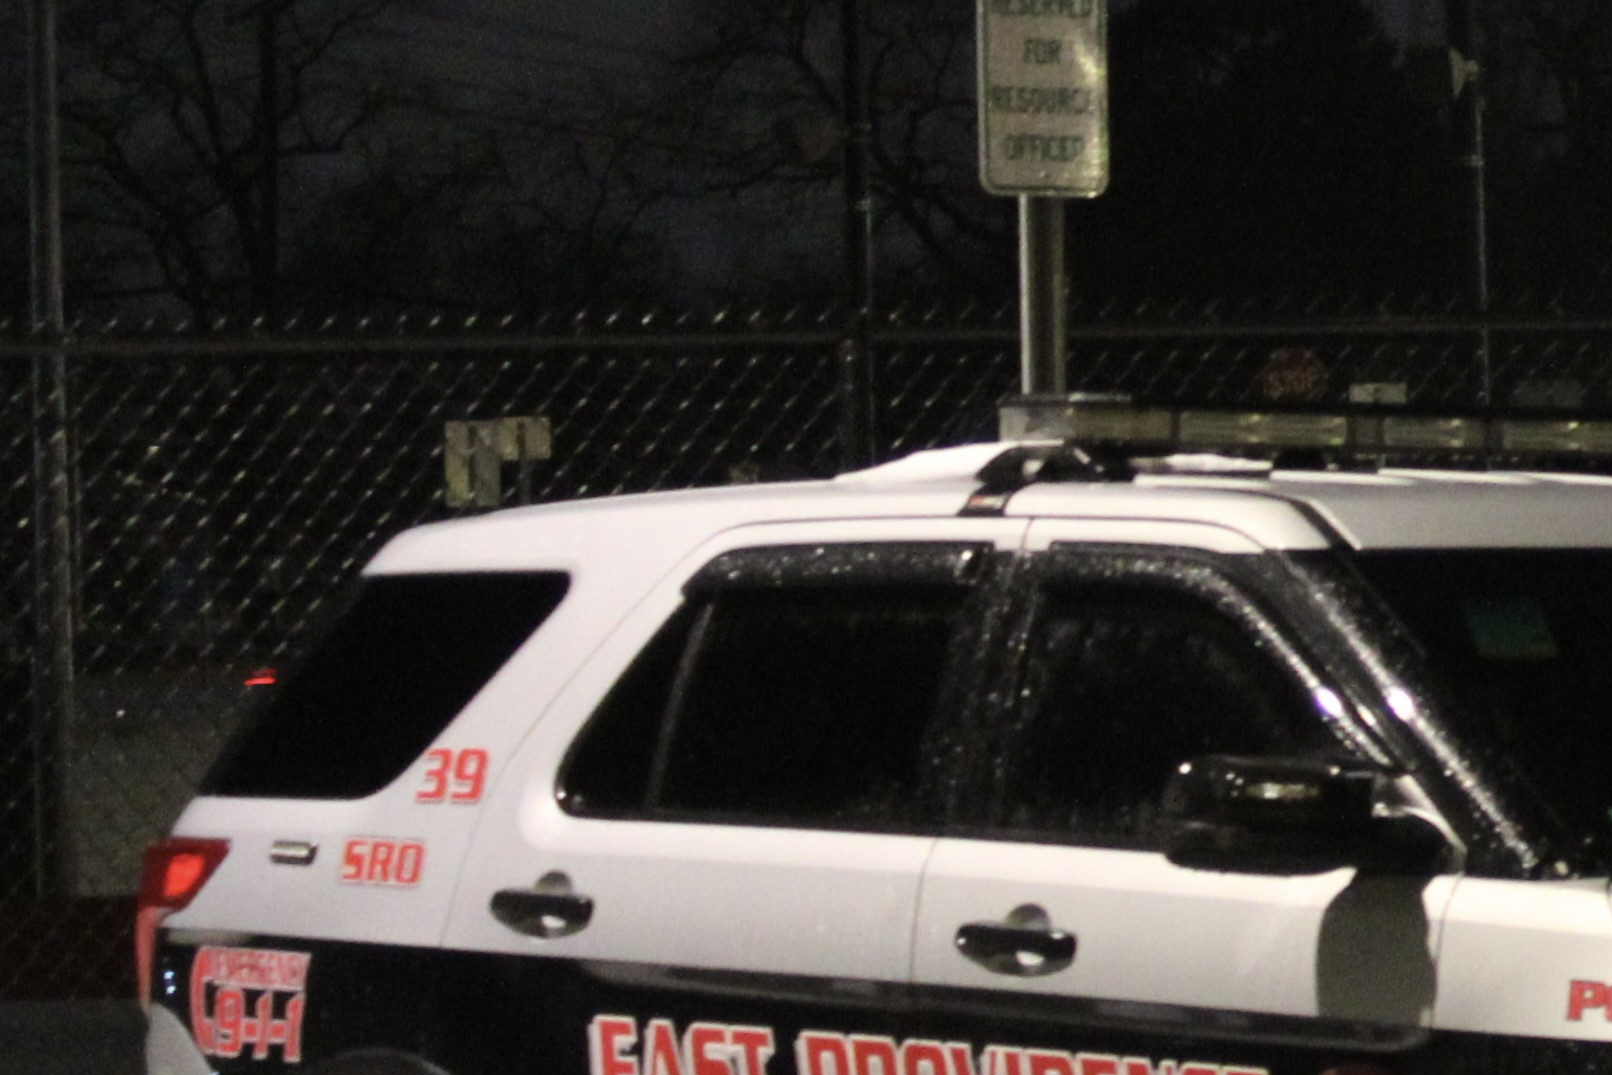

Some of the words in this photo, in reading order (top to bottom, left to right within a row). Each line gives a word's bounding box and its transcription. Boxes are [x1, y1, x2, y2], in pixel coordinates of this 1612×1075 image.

[1023, 37, 1062, 64] FOR
[416, 747, 489, 804] 39
[340, 835, 427, 889] SRO
